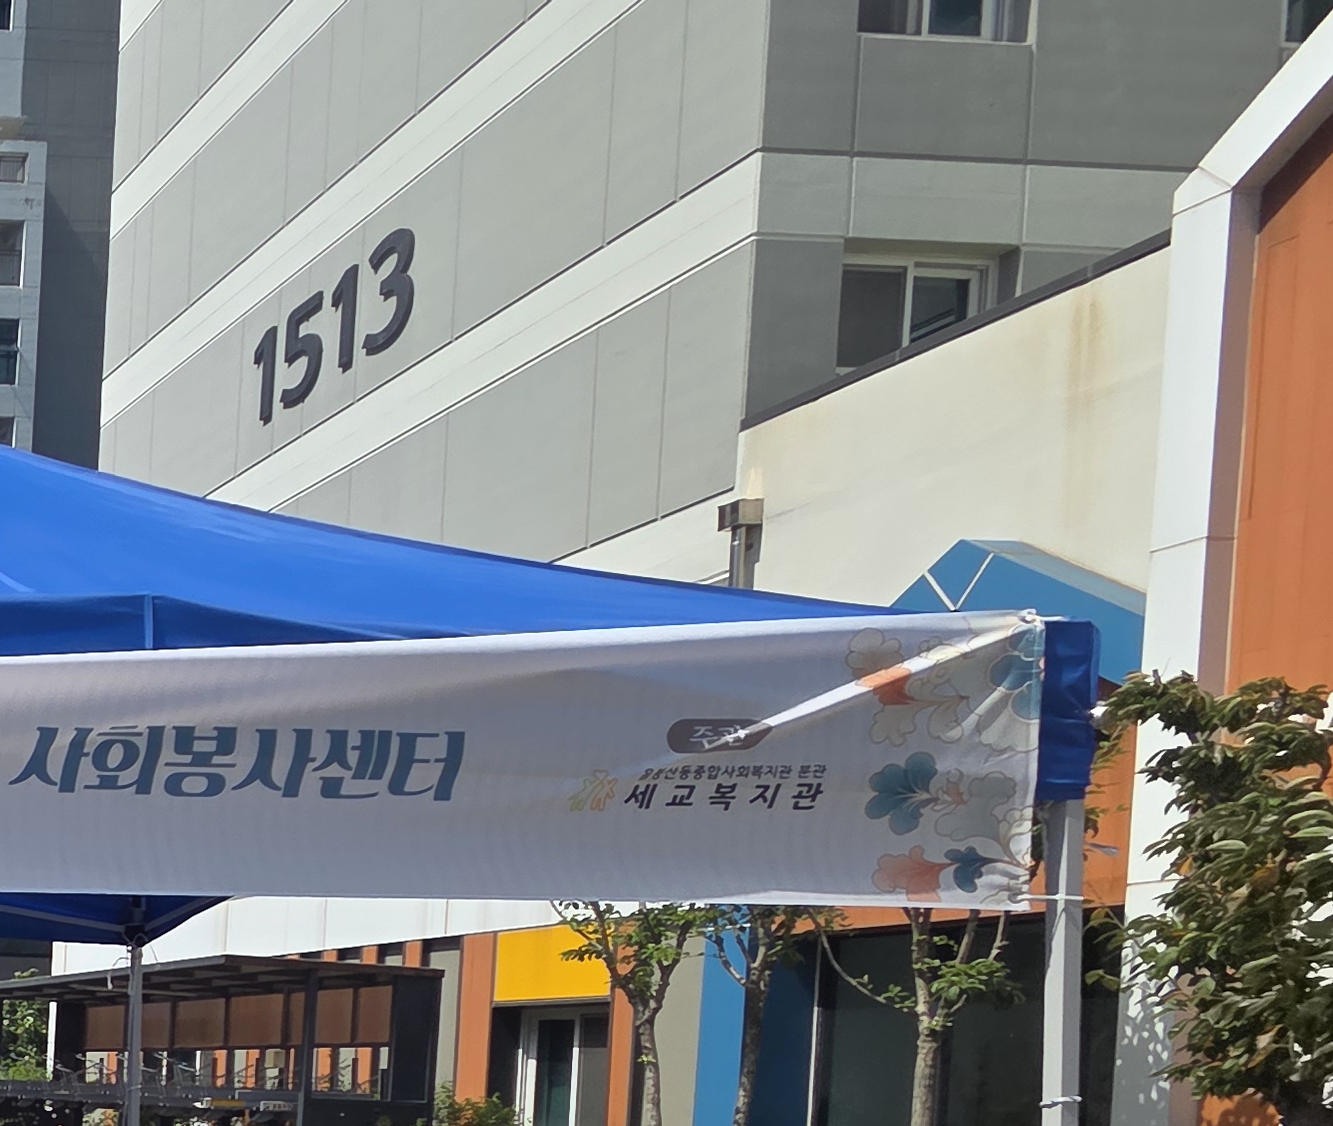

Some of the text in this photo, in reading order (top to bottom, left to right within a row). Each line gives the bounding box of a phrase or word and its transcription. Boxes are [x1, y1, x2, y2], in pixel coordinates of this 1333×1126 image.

[253, 227, 416, 427] 1513
[7, 721, 468, 802] 사회봉사센터
[623, 782, 825, 812] 세교복지관
